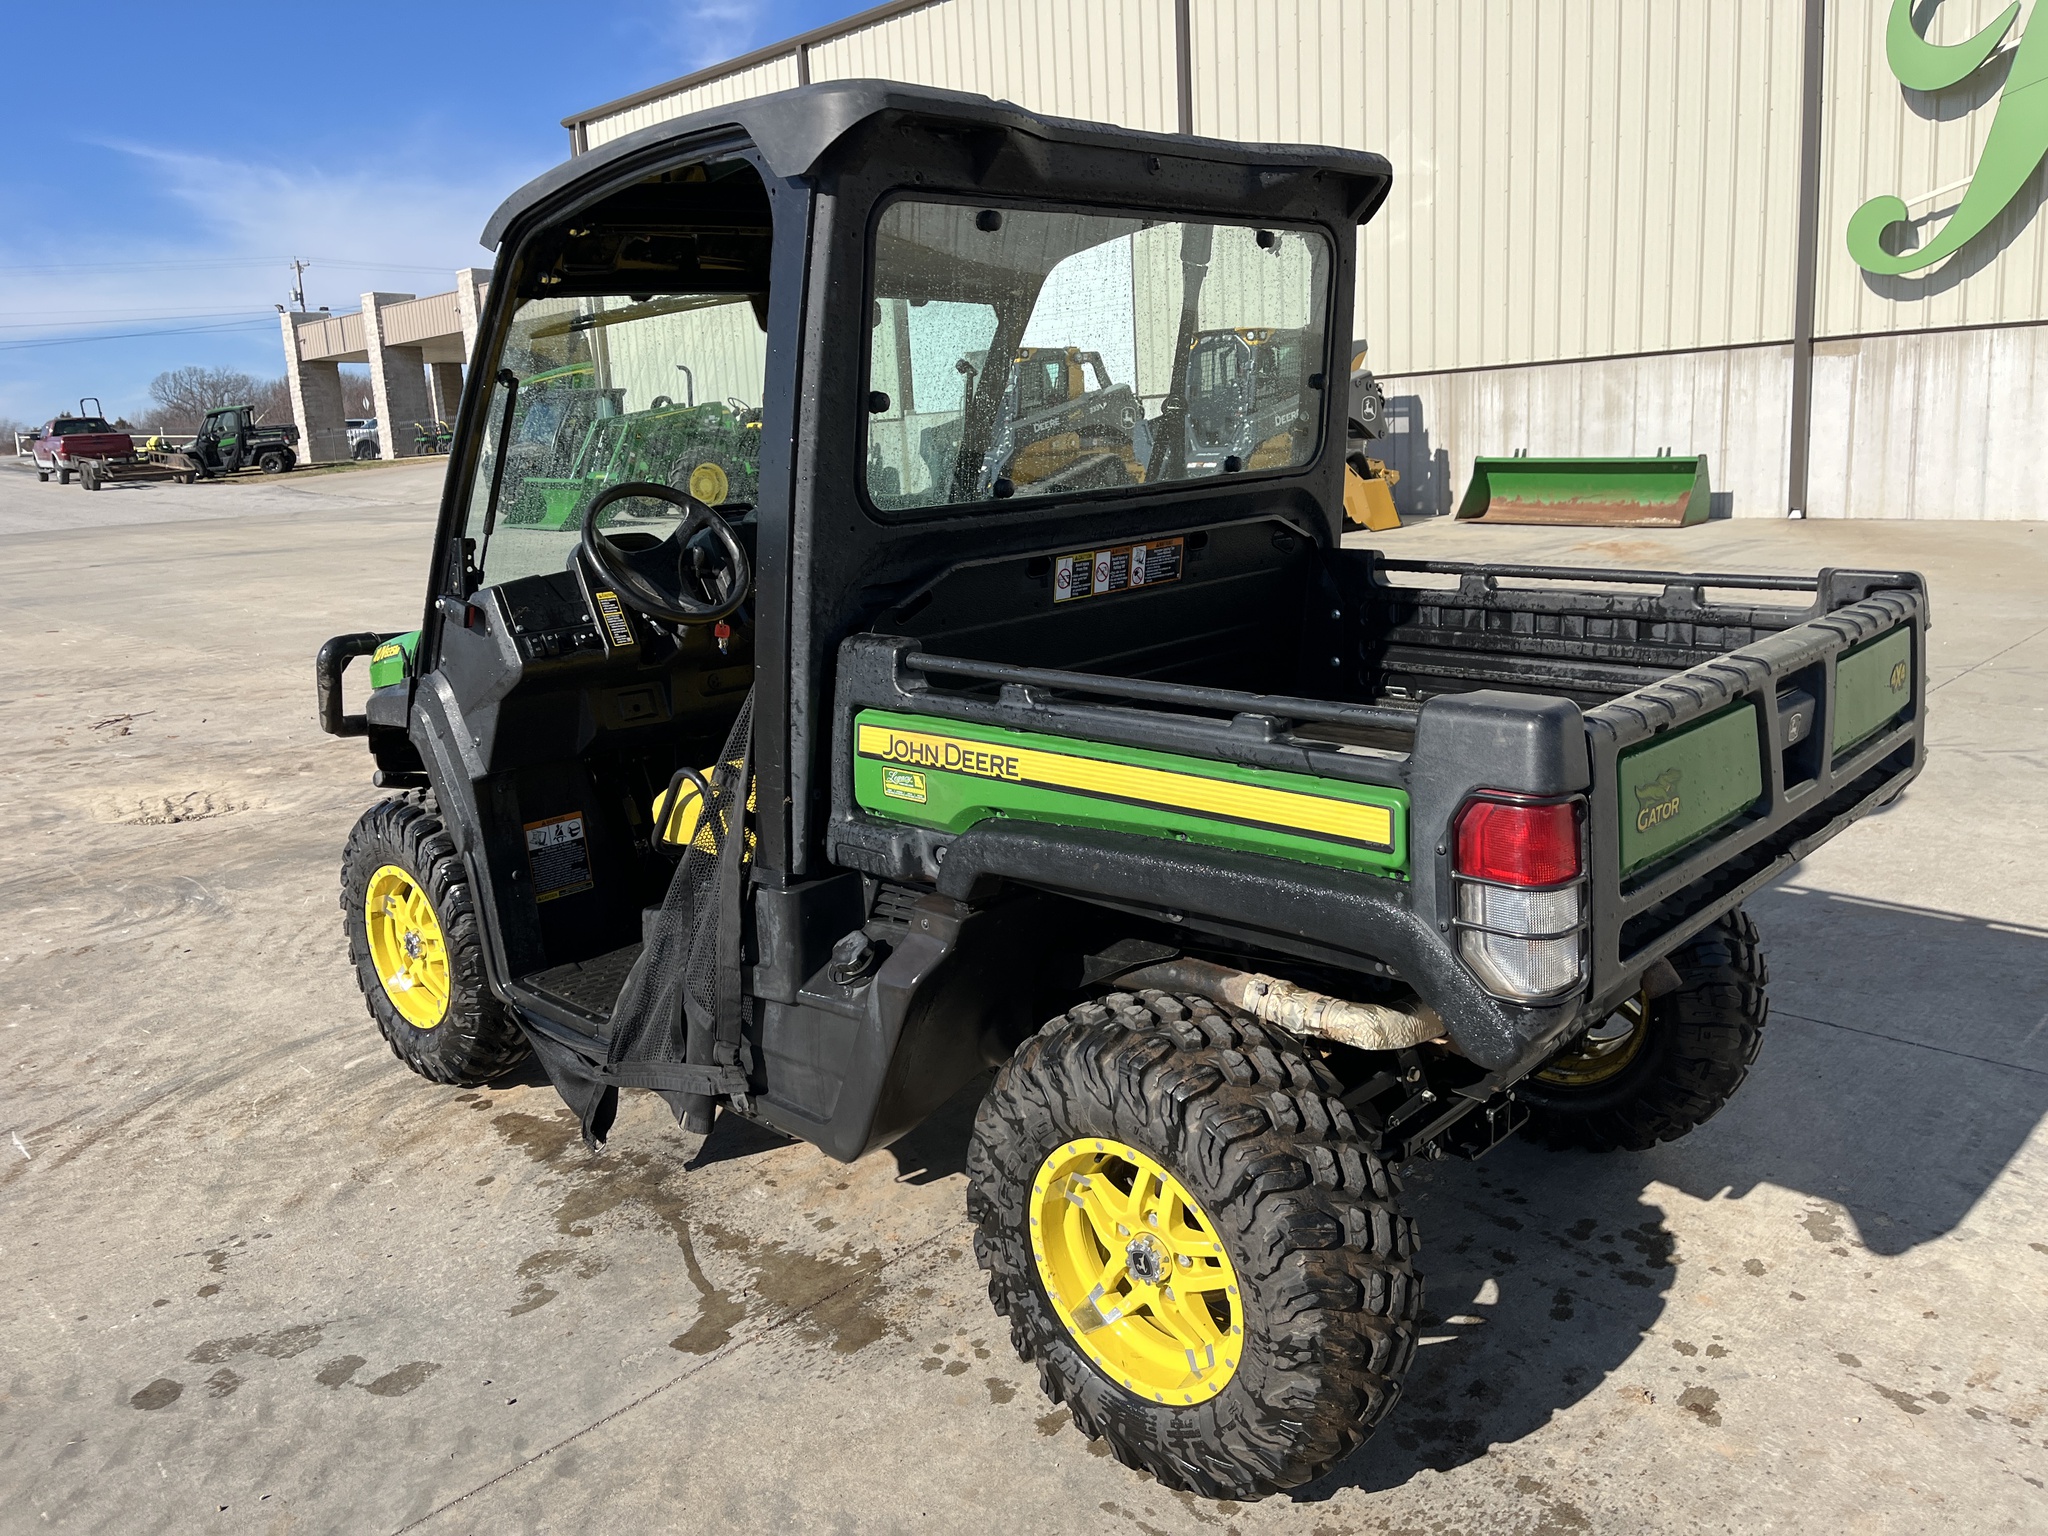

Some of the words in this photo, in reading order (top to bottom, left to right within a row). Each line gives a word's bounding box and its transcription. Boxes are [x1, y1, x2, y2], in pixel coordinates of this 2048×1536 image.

[1033, 416, 1061, 433] DEERE
[883, 734, 939, 763] JOHN
[945, 743, 1019, 777] DEERE
[1638, 797, 1679, 831] GATOR
